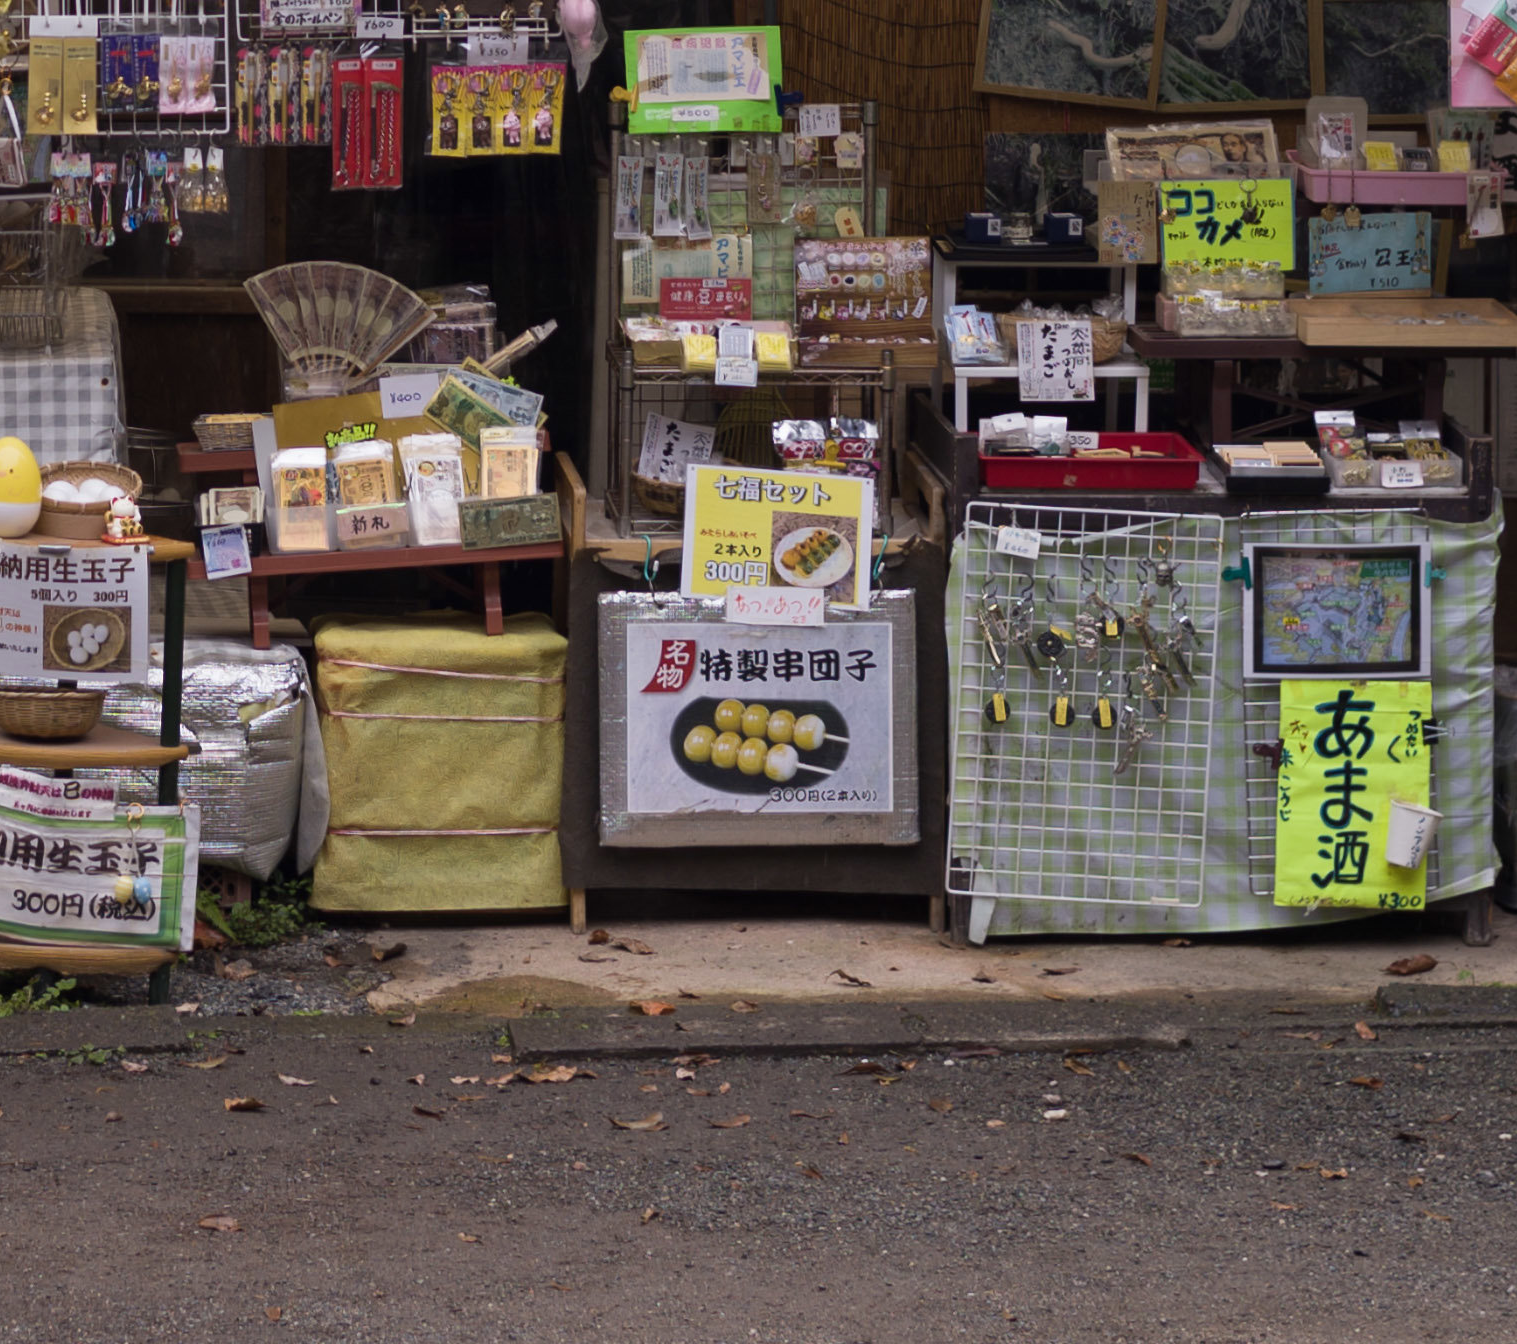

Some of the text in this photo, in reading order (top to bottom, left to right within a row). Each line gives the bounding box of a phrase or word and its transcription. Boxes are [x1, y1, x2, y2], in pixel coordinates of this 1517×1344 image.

[271, 11, 343, 27] 金のボールペン
[1196, 218, 1243, 247] カメ
[388, 390, 423, 404] ¥400
[713, 475, 831, 507] 七福セット
[351, 514, 390, 535] 新札
[714, 542, 763, 558] 2本入り
[704, 561, 768, 586] 300円
[30, 588, 129, 603] 5個入り 300円
[656, 640, 691, 689] 名物
[700, 648, 877, 683] 特製串団子
[769, 788, 878, 804] 300円(2本入り)
[1311, 688, 1375, 888] あま酒
[12, 887, 84, 919] 300円
[1378, 892, 1422, 909] ¥300
